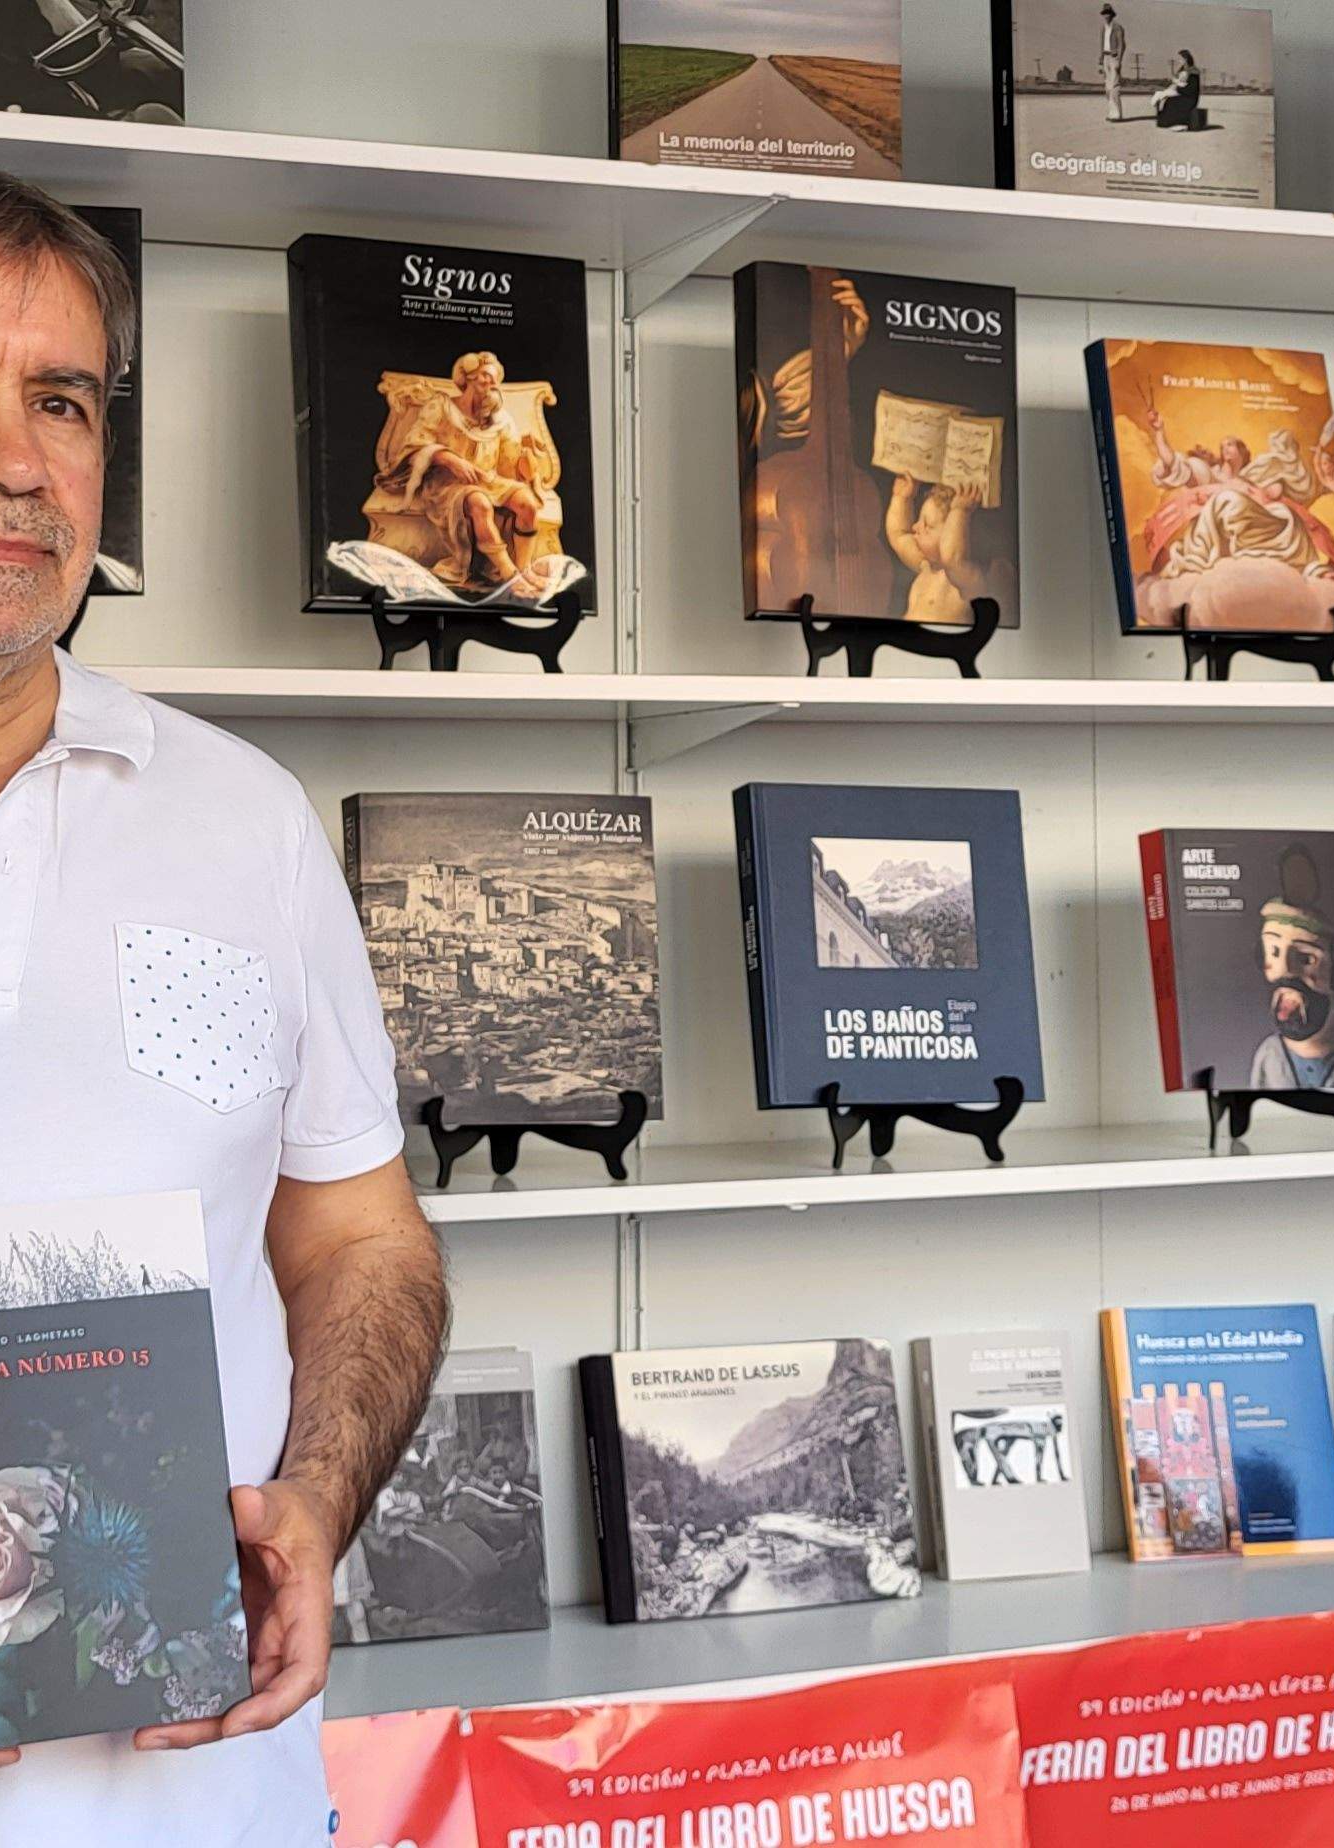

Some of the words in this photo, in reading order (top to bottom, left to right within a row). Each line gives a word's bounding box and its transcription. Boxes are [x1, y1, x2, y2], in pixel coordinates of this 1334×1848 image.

[659, 132, 680, 148] La
[684, 134, 755, 152] memoria
[758, 138, 783, 154] del
[787, 140, 856, 157] territorio
[1030, 152, 1127, 175] Geografías
[1130, 158, 1157, 177] del
[1161, 161, 1203, 182] viaje
[401, 254, 513, 300] Signos
[885, 300, 1002, 337] SIGNOS
[523, 808, 642, 833] ALQUÉZAR
[1181, 848, 1216, 864] ARTE
[824, 1009, 867, 1034] LOS
[872, 1005, 945, 1034] BAÑOS
[826, 1035, 856, 1060] DE
[860, 1035, 979, 1060] PANTICOSA
[1135, 1332, 1186, 1349] Huesca
[1187, 1335, 1205, 1348] en
[1205, 1332, 1221, 1348] la
[1222, 1331, 1258, 1348] Edad
[1258, 1330, 1305, 1347] Media
[17, 1347, 126, 1377] NÚMERO
[132, 1349, 150, 1368] 15
[631, 1367, 715, 1386] BERTRAND
[718, 1366, 739, 1381] DE
[742, 1363, 801, 1380] LASSUS
[1078, 1699, 1103, 1719] 39
[1109, 1688, 1185, 1716] EDICIÓN
[1201, 1681, 1265, 1705] PLAZA
[1269, 1674, 1326, 1697] LÓPEZ
[567, 1776, 595, 1798] 39
[601, 1766, 688, 1797] EDICIÓN
[705, 1756, 772, 1784] PLAZA
[777, 1744, 838, 1772] LÓPEZ
[840, 1730, 906, 1763] ALLUÉ
[1020, 1737, 1107, 1789] FERIA
[1114, 1732, 1169, 1779] DEL
[1176, 1719, 1268, 1771] LIBRO
[1273, 1713, 1315, 1759] DE
[680, 1798, 782, 1848] LIBRO
[788, 1791, 835, 1848] DE
[840, 1776, 976, 1841] HUESCA
